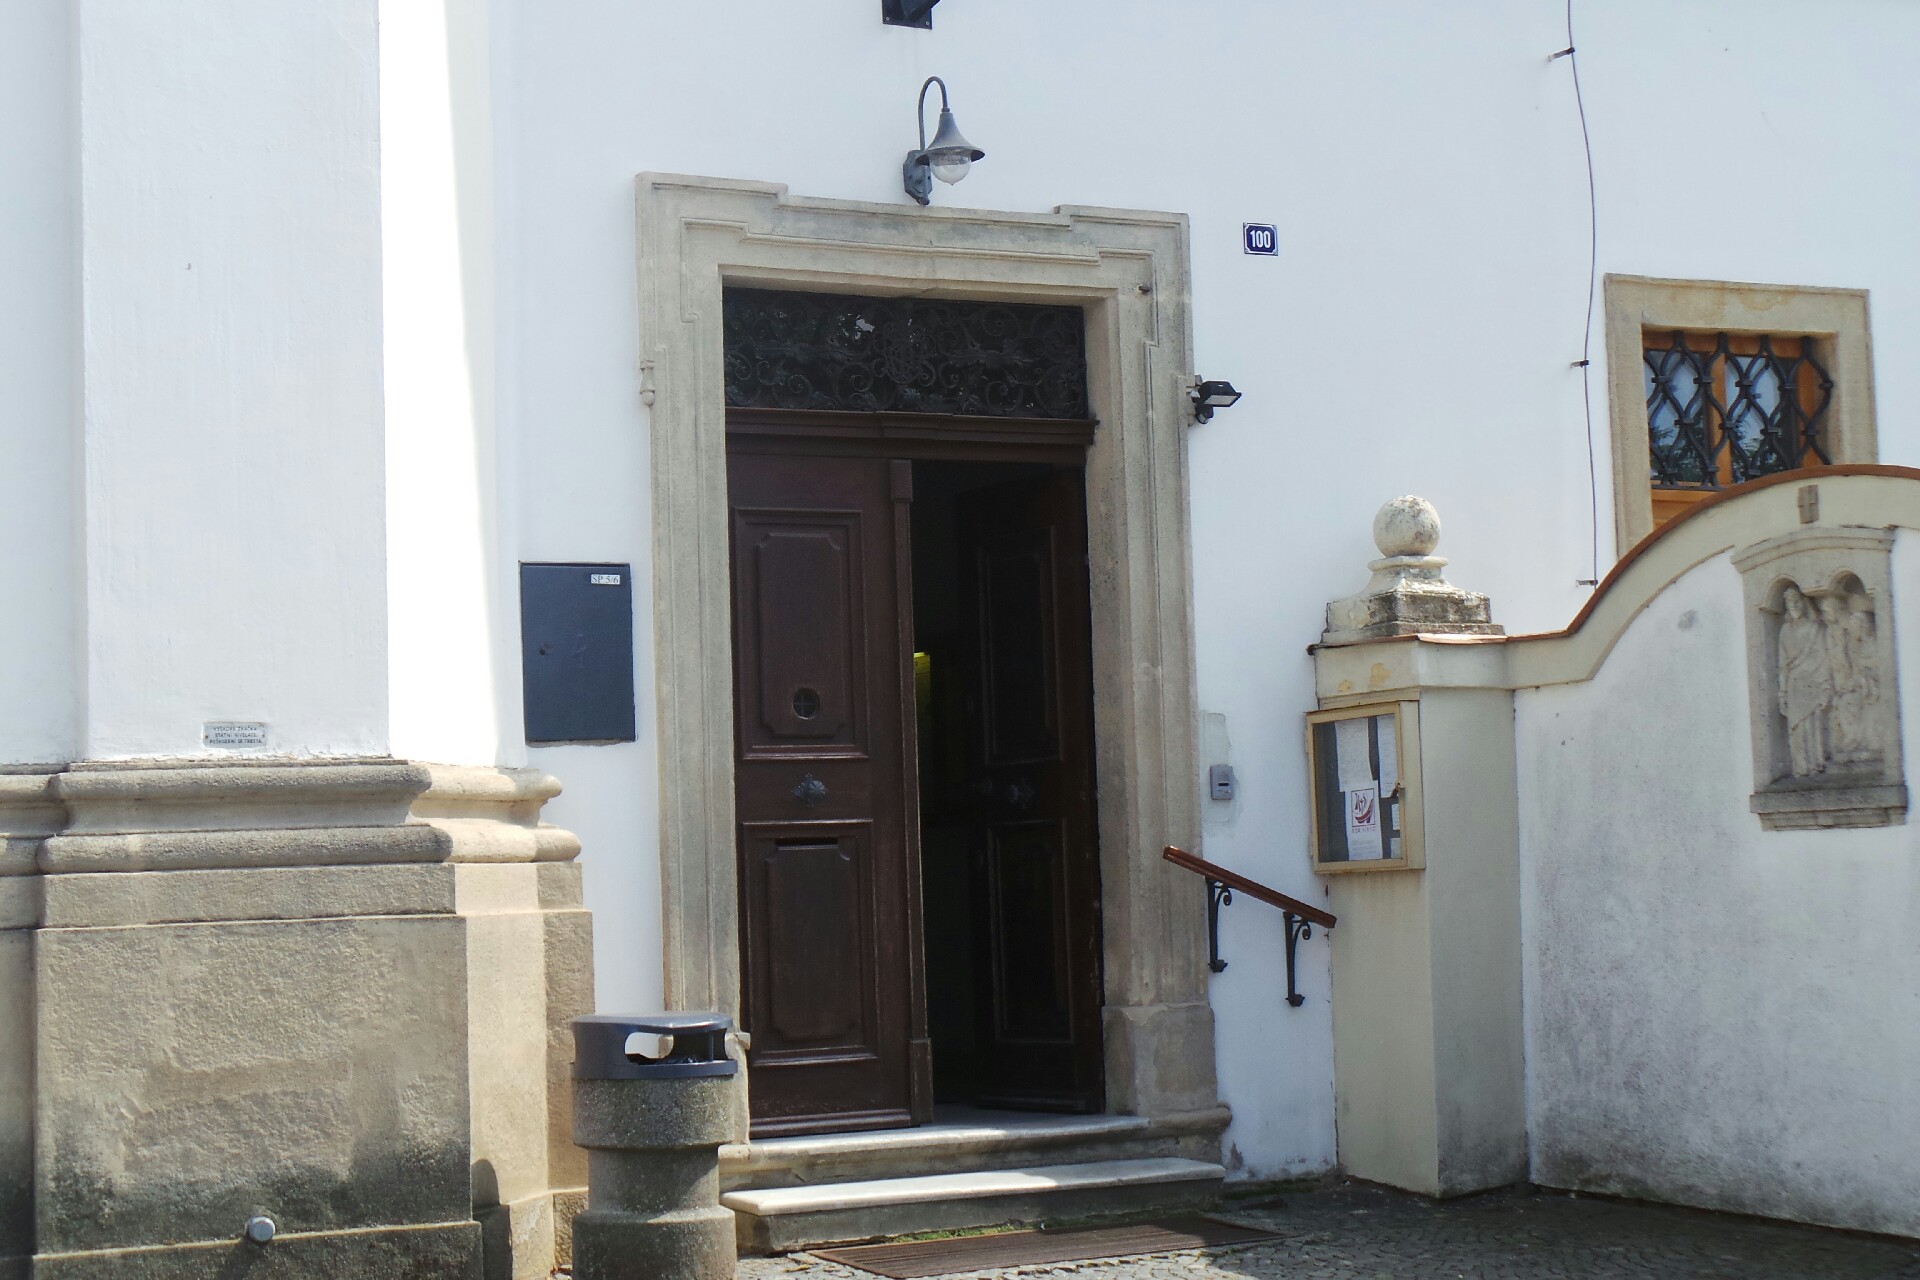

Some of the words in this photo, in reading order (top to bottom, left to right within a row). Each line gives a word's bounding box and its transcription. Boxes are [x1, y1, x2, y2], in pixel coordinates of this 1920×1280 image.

[1249, 229, 1271, 249] 100
[591, 575, 603, 584] SP
[605, 575, 619, 584] 5/6
